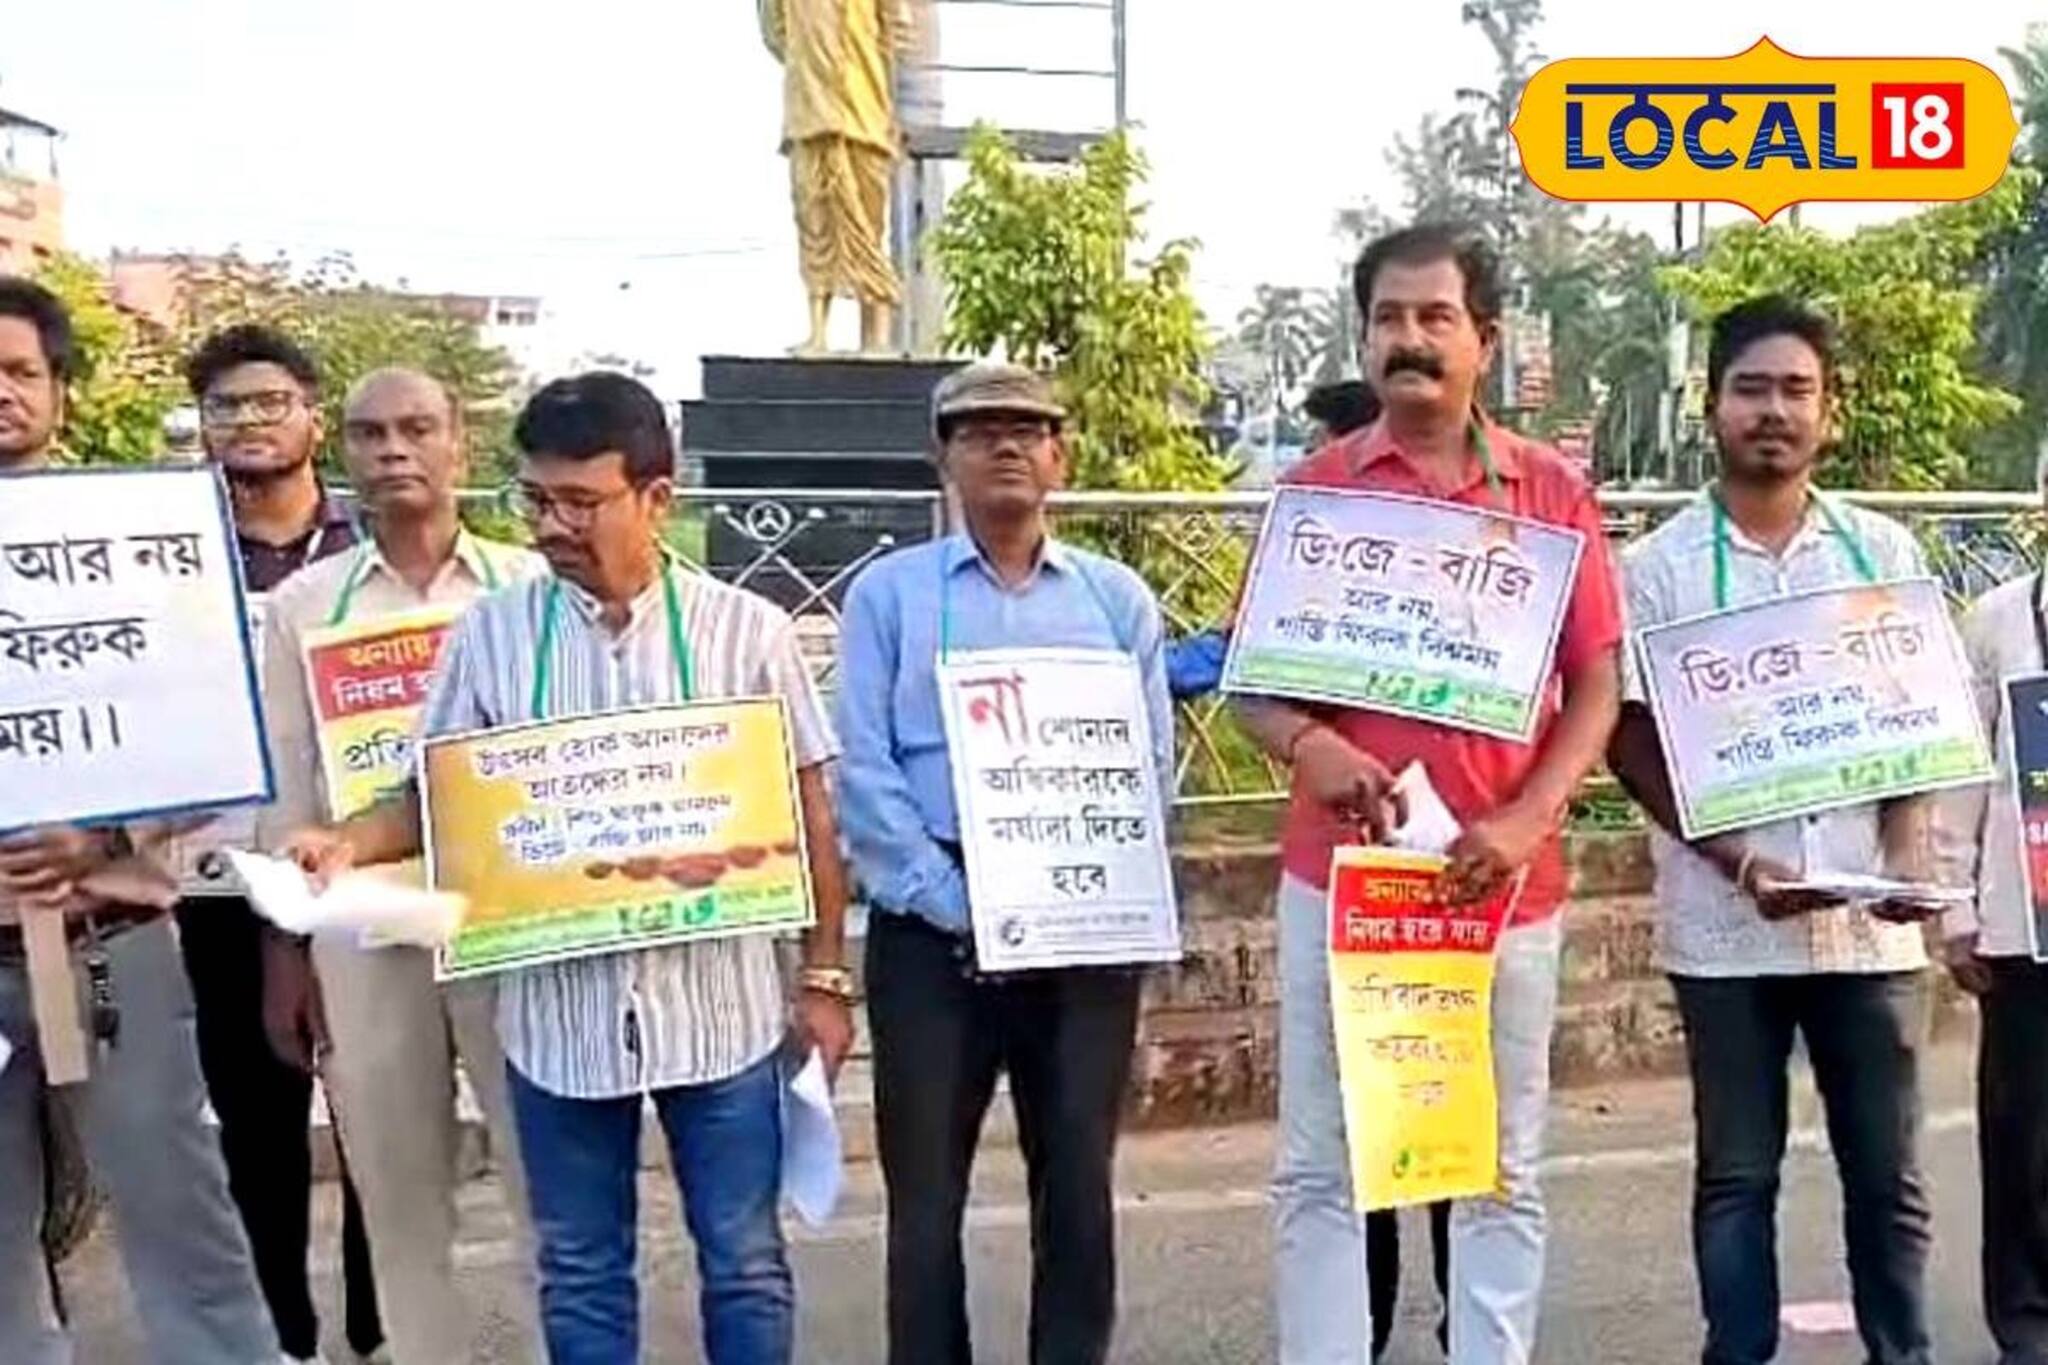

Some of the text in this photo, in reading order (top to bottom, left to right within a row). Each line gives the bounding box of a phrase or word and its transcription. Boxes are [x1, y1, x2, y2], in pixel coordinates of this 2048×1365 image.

[3, 533, 203, 586] আর নয়
[1440, 546, 1536, 606] বাজি
[958, 669, 1027, 745] না
